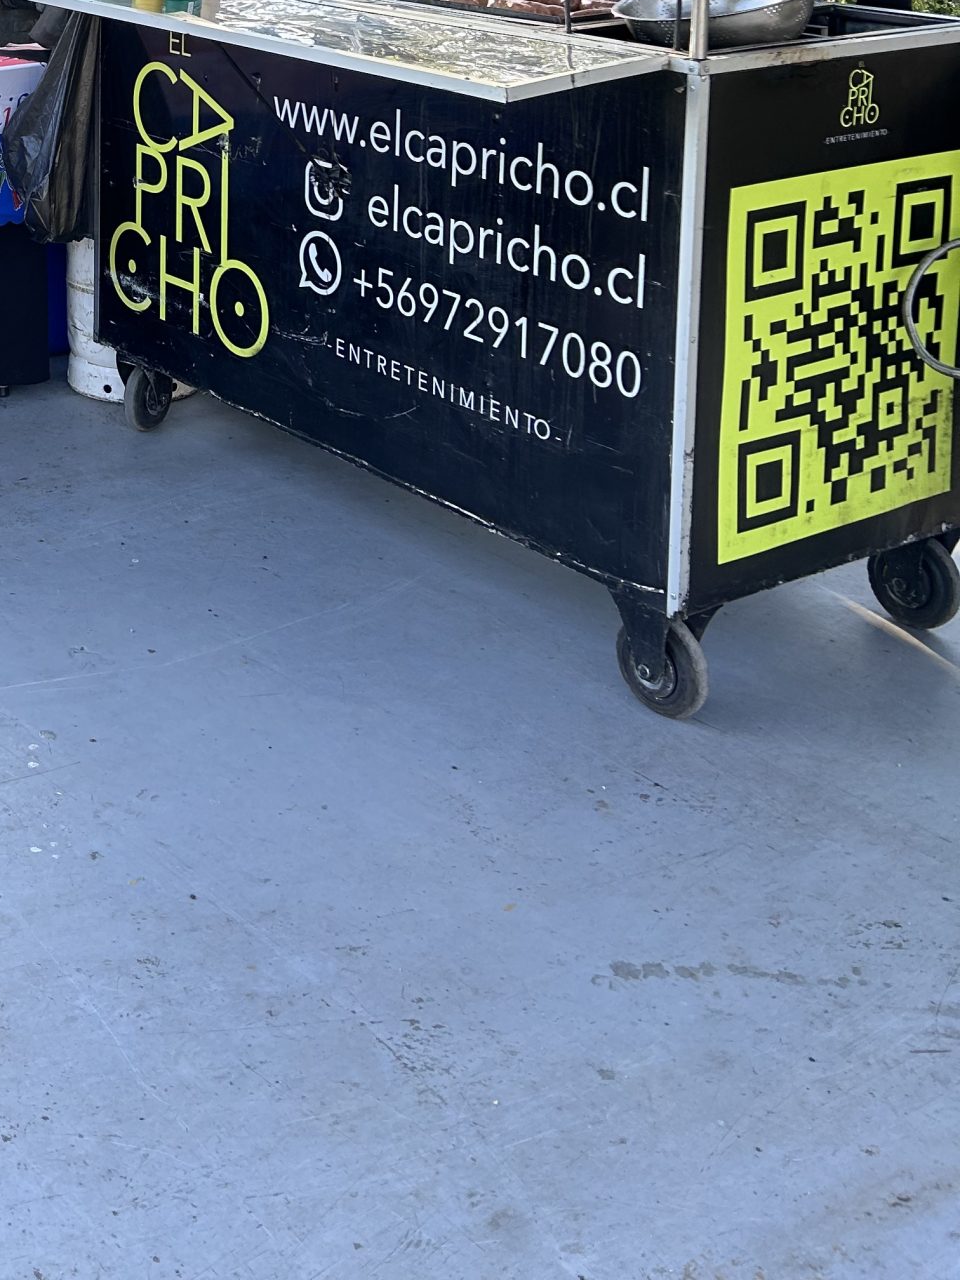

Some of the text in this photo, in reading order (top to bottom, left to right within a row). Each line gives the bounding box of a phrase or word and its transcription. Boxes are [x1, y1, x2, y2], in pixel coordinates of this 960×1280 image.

[169, 31, 192, 58] EL
[273, 95, 650, 222] www.elcapricho.cl
[368, 184, 646, 309] elcapricho.cl
[353, 266, 642, 399] +56972917080
